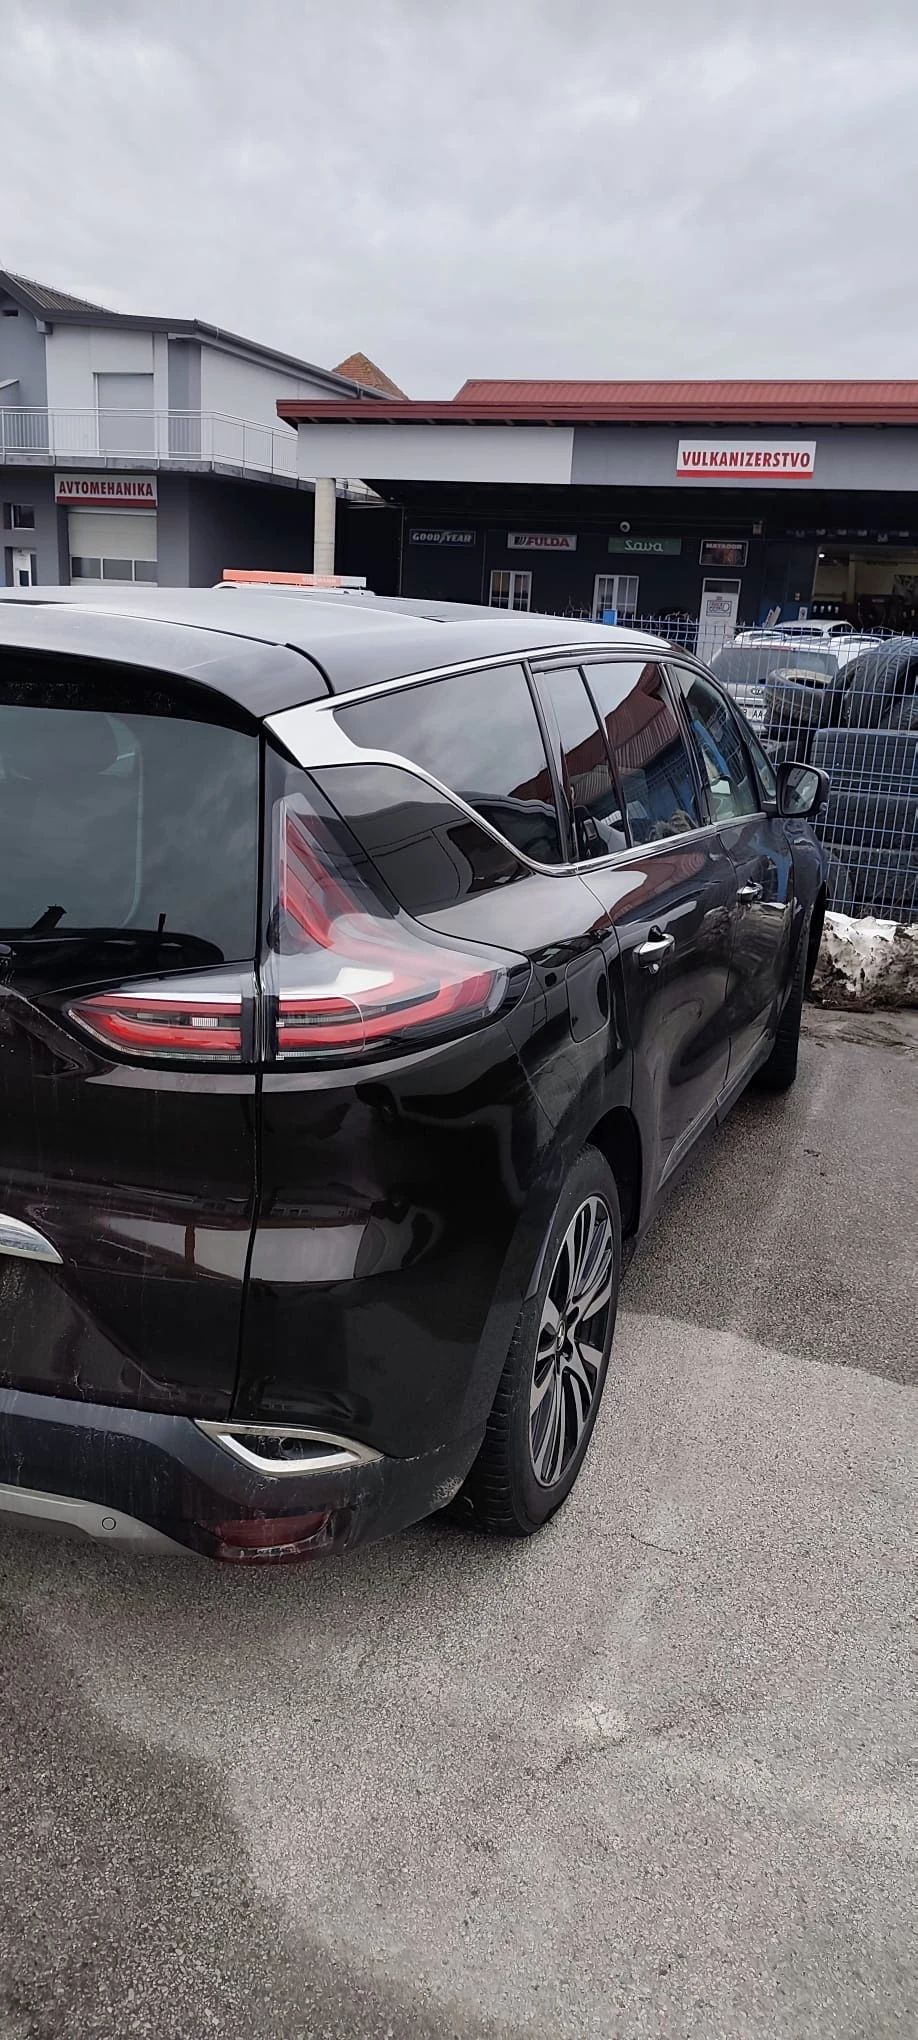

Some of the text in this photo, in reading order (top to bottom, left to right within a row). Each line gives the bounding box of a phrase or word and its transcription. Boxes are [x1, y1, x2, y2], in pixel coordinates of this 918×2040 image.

[682, 451, 810, 468] VULKANIZERSTVO
[59, 480, 153, 496] AVTOMEHANIKA
[525, 536, 570, 547] FULDA
[624, 539, 664, 552] Sava
